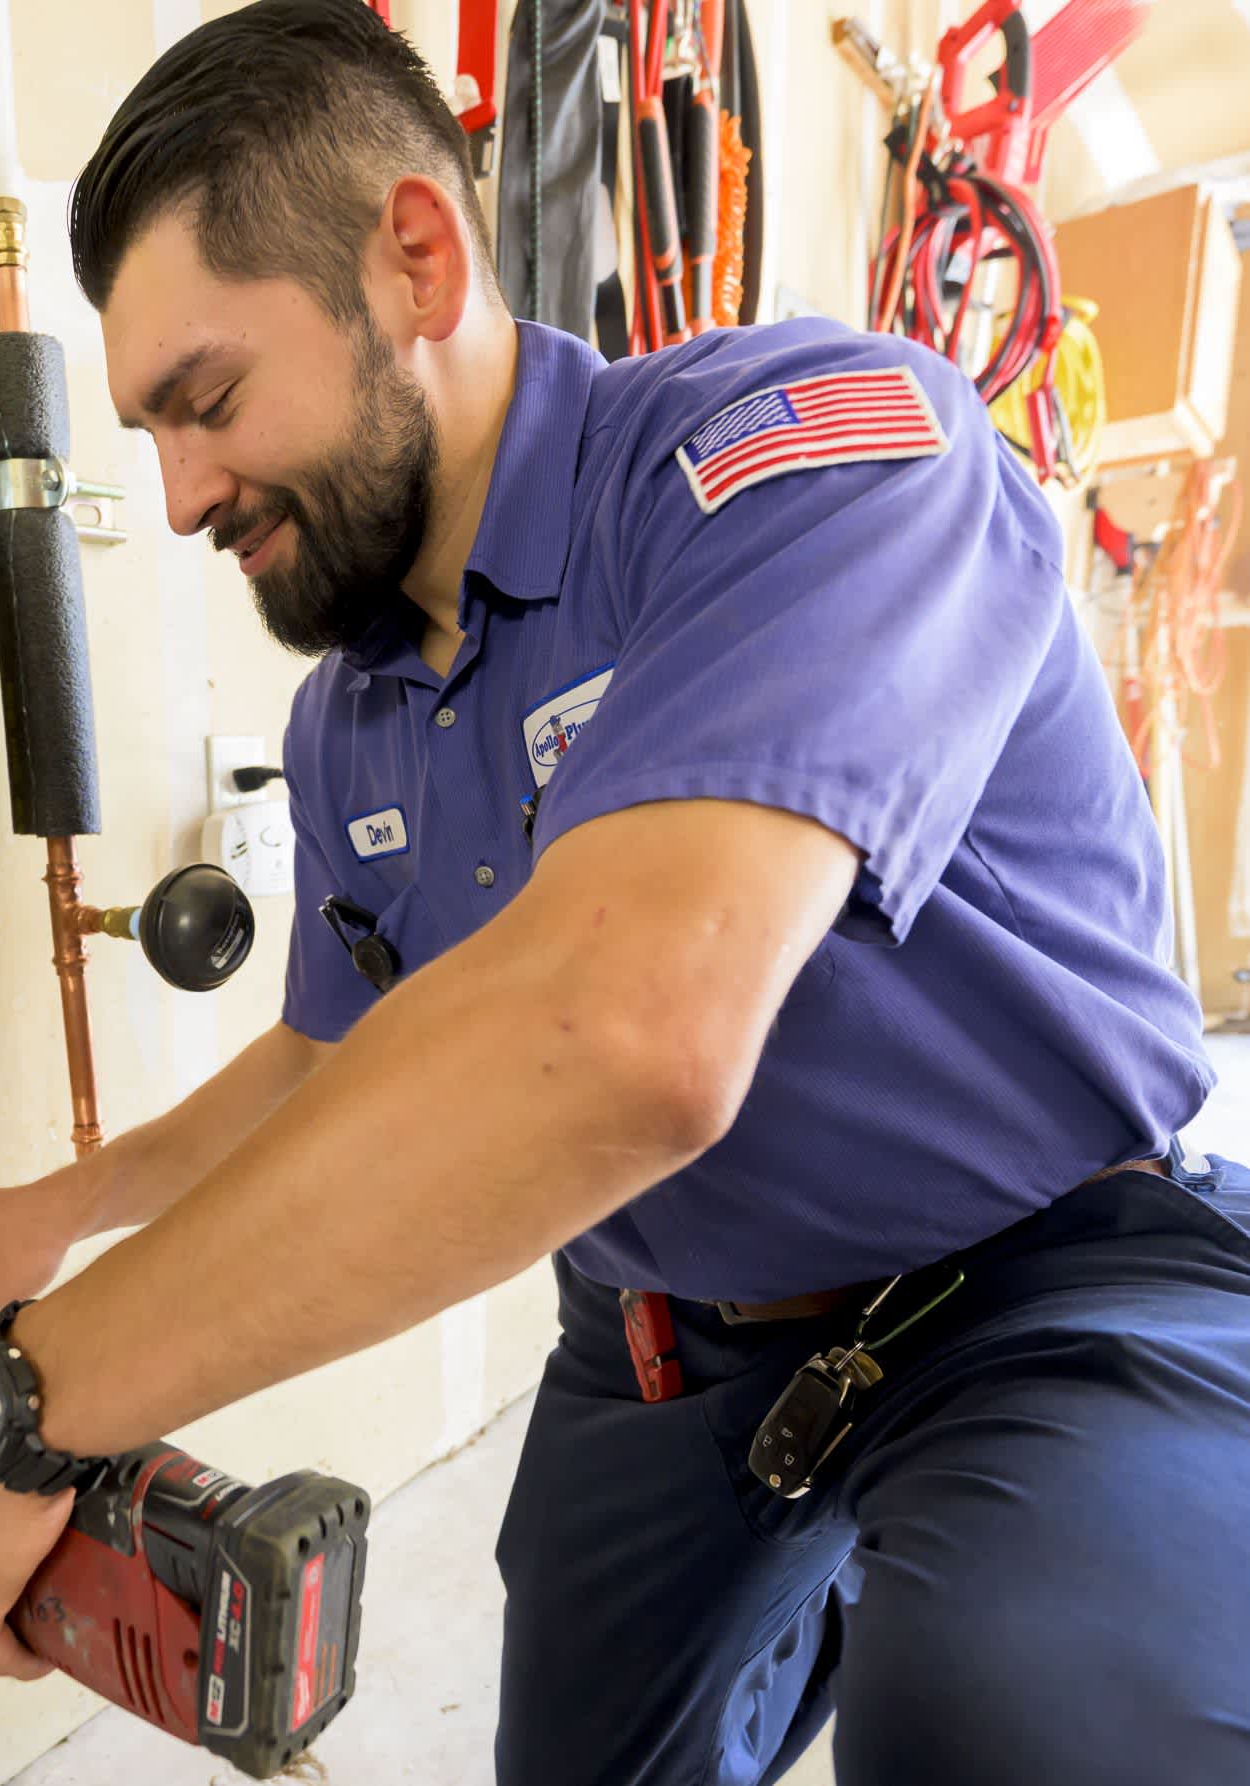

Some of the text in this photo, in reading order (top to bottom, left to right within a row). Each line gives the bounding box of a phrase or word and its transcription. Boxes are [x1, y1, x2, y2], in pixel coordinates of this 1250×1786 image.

[535, 722, 589, 757] Apollo Pl
[366, 820, 394, 846] Devin
